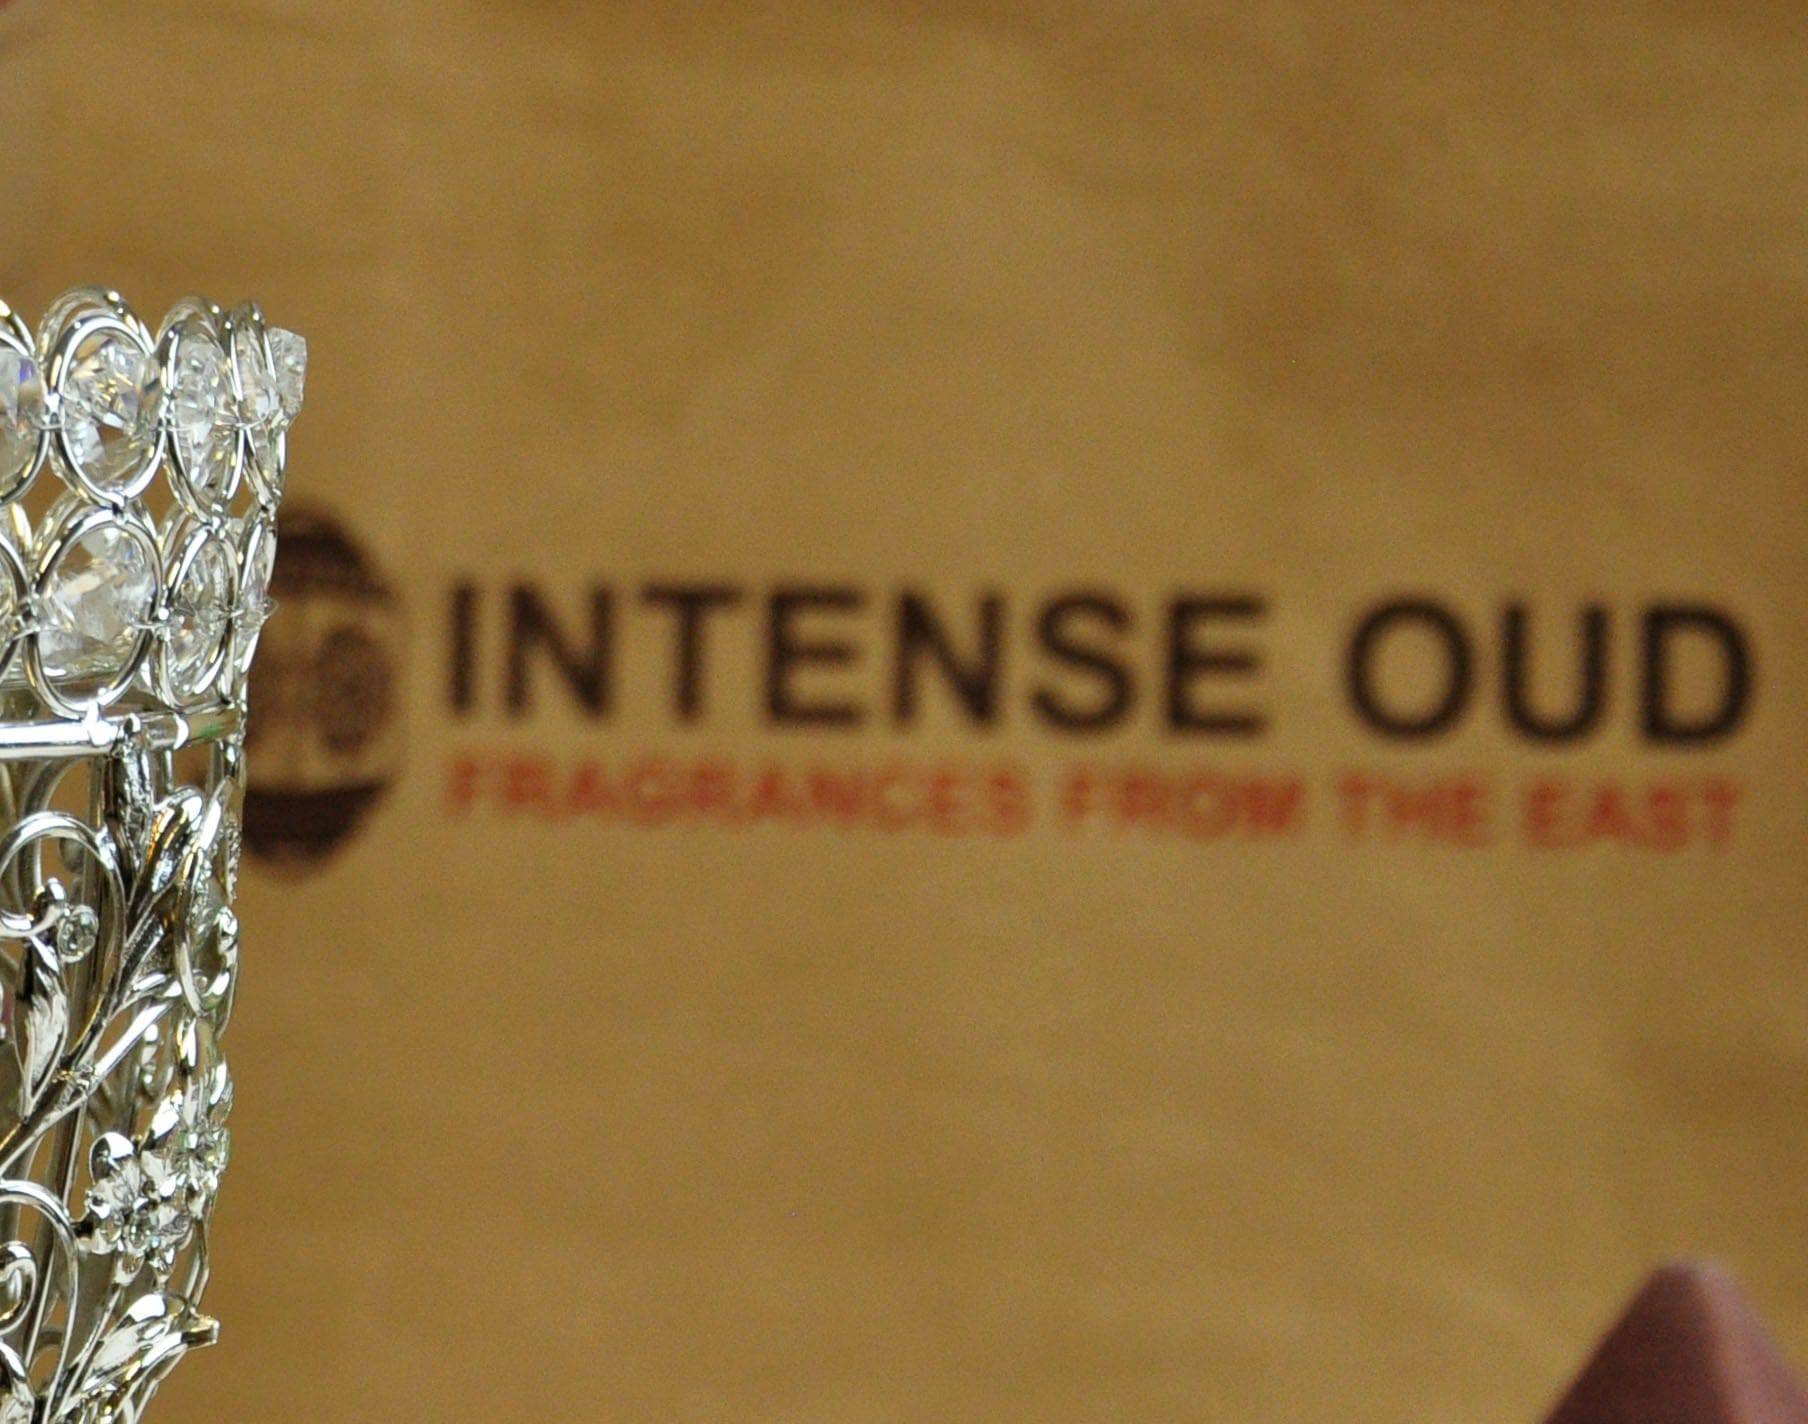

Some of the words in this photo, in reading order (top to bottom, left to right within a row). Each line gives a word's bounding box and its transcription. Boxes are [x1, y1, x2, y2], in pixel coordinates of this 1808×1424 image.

[446, 577, 1269, 741] INTENSE
[1340, 592, 1760, 754] OUD
[449, 752, 1031, 838] FRAGRANCES
[1060, 765, 1306, 840] FROM
[1336, 774, 1490, 845] THE
[1525, 778, 1744, 851] EAST
